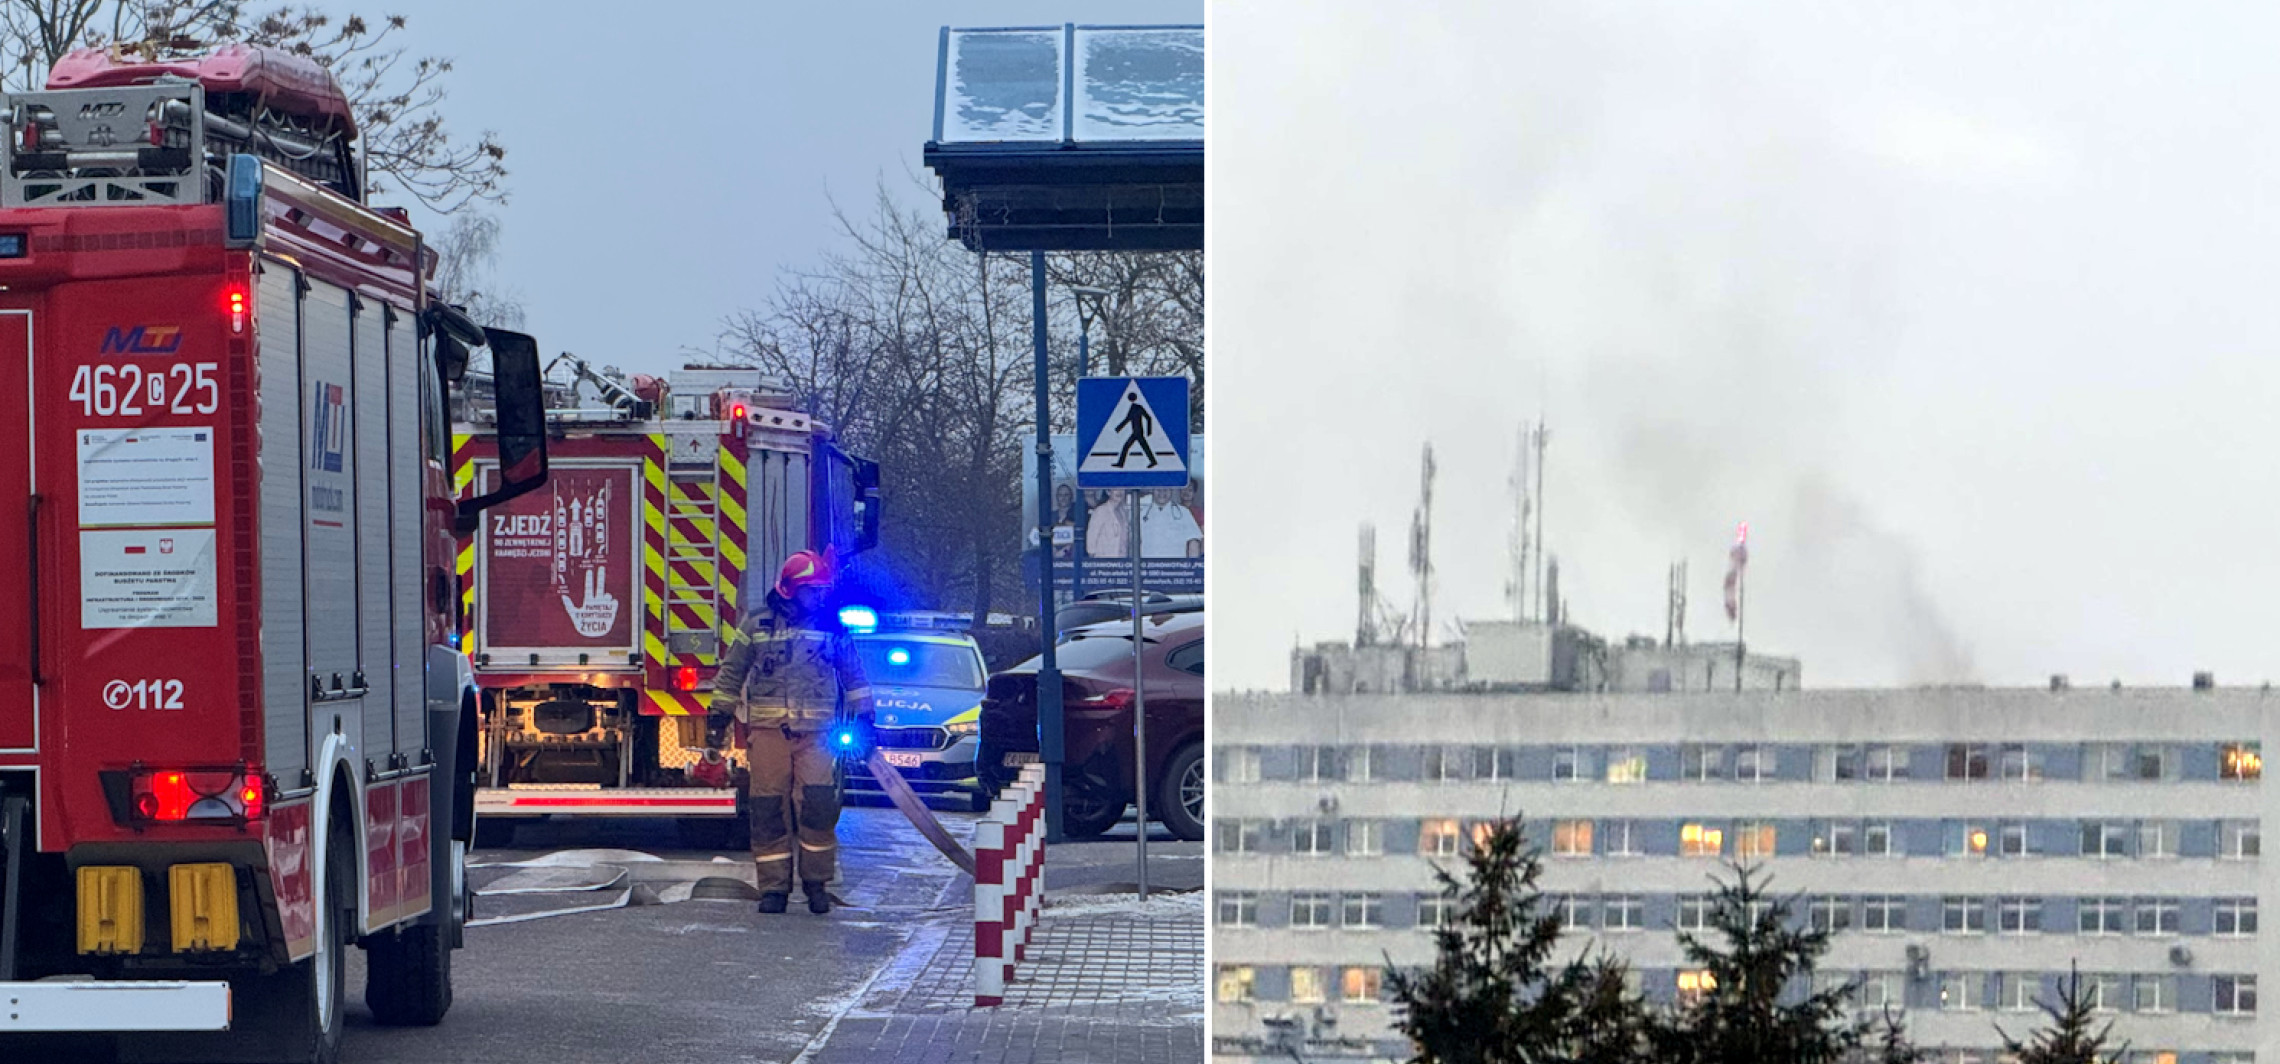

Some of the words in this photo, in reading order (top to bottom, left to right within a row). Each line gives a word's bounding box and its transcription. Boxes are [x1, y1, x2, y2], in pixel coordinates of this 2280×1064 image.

[494, 510, 552, 536] ZJEDŹ
[580, 619, 607, 632] ŻYCIA
[133, 679, 184, 709] 112
[876, 699, 933, 712] LICJA
